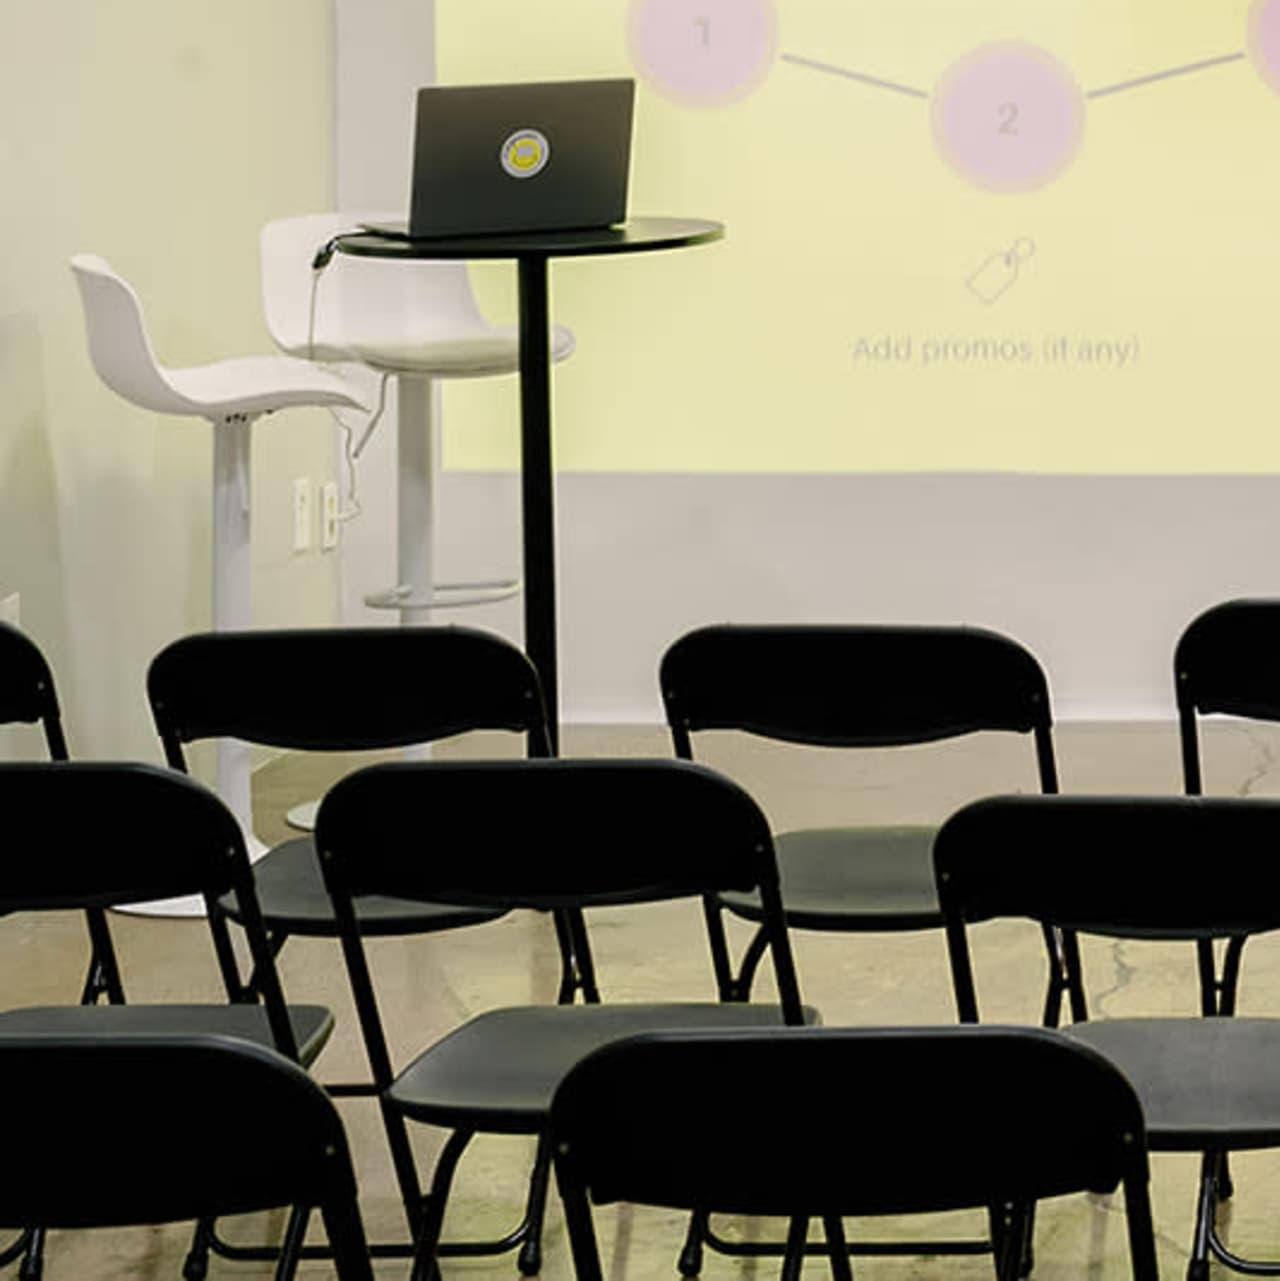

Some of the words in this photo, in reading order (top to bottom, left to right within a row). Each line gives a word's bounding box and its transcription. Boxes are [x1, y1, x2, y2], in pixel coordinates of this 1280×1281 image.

[691, 16, 711, 48] 1
[997, 101, 1019, 137] 2
[852, 334, 911, 363] Add
[922, 338, 1033, 370] promos
